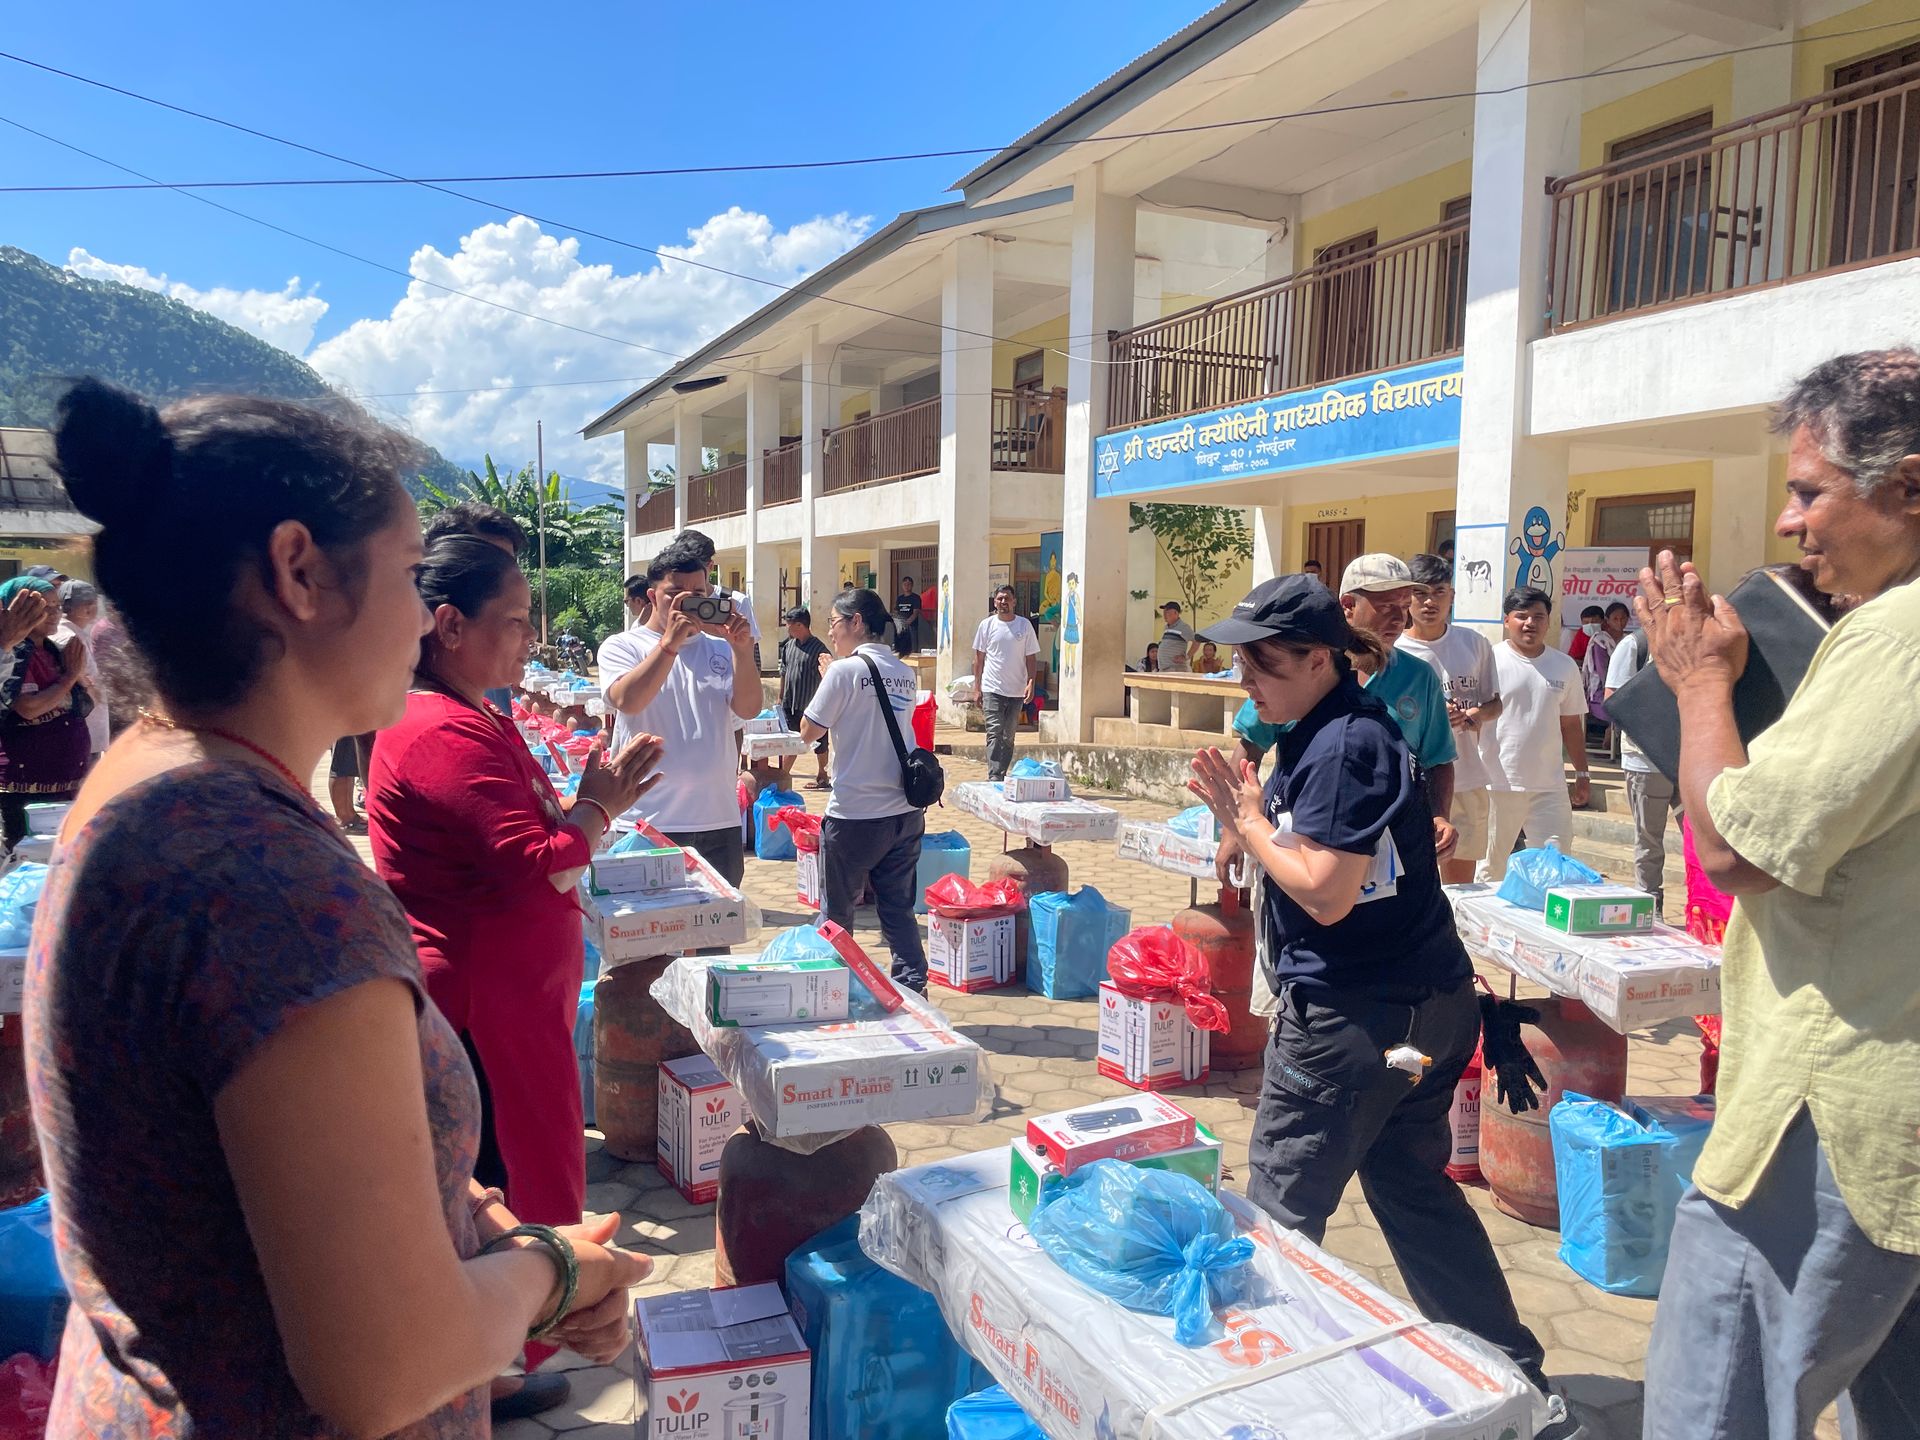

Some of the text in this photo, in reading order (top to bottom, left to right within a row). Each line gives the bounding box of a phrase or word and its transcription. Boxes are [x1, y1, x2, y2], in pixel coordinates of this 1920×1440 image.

[1124, 435, 1143, 465] श्री
[1146, 423, 1196, 460] सुन्दरी
[1273, 390, 1367, 432] माध्यमिक
[861, 676, 892, 690] pece
[610, 926, 645, 939] Smart
[1154, 1019, 1174, 1032] TULIP
[783, 1076, 893, 1104] Smart Flame
[1460, 1102, 1480, 1112] TULI
[699, 1111, 731, 1127] TULIP
[970, 1291, 1018, 1366] Smart
[1024, 1339, 1080, 1427] Flame
[656, 1412, 709, 1434] TULIP
